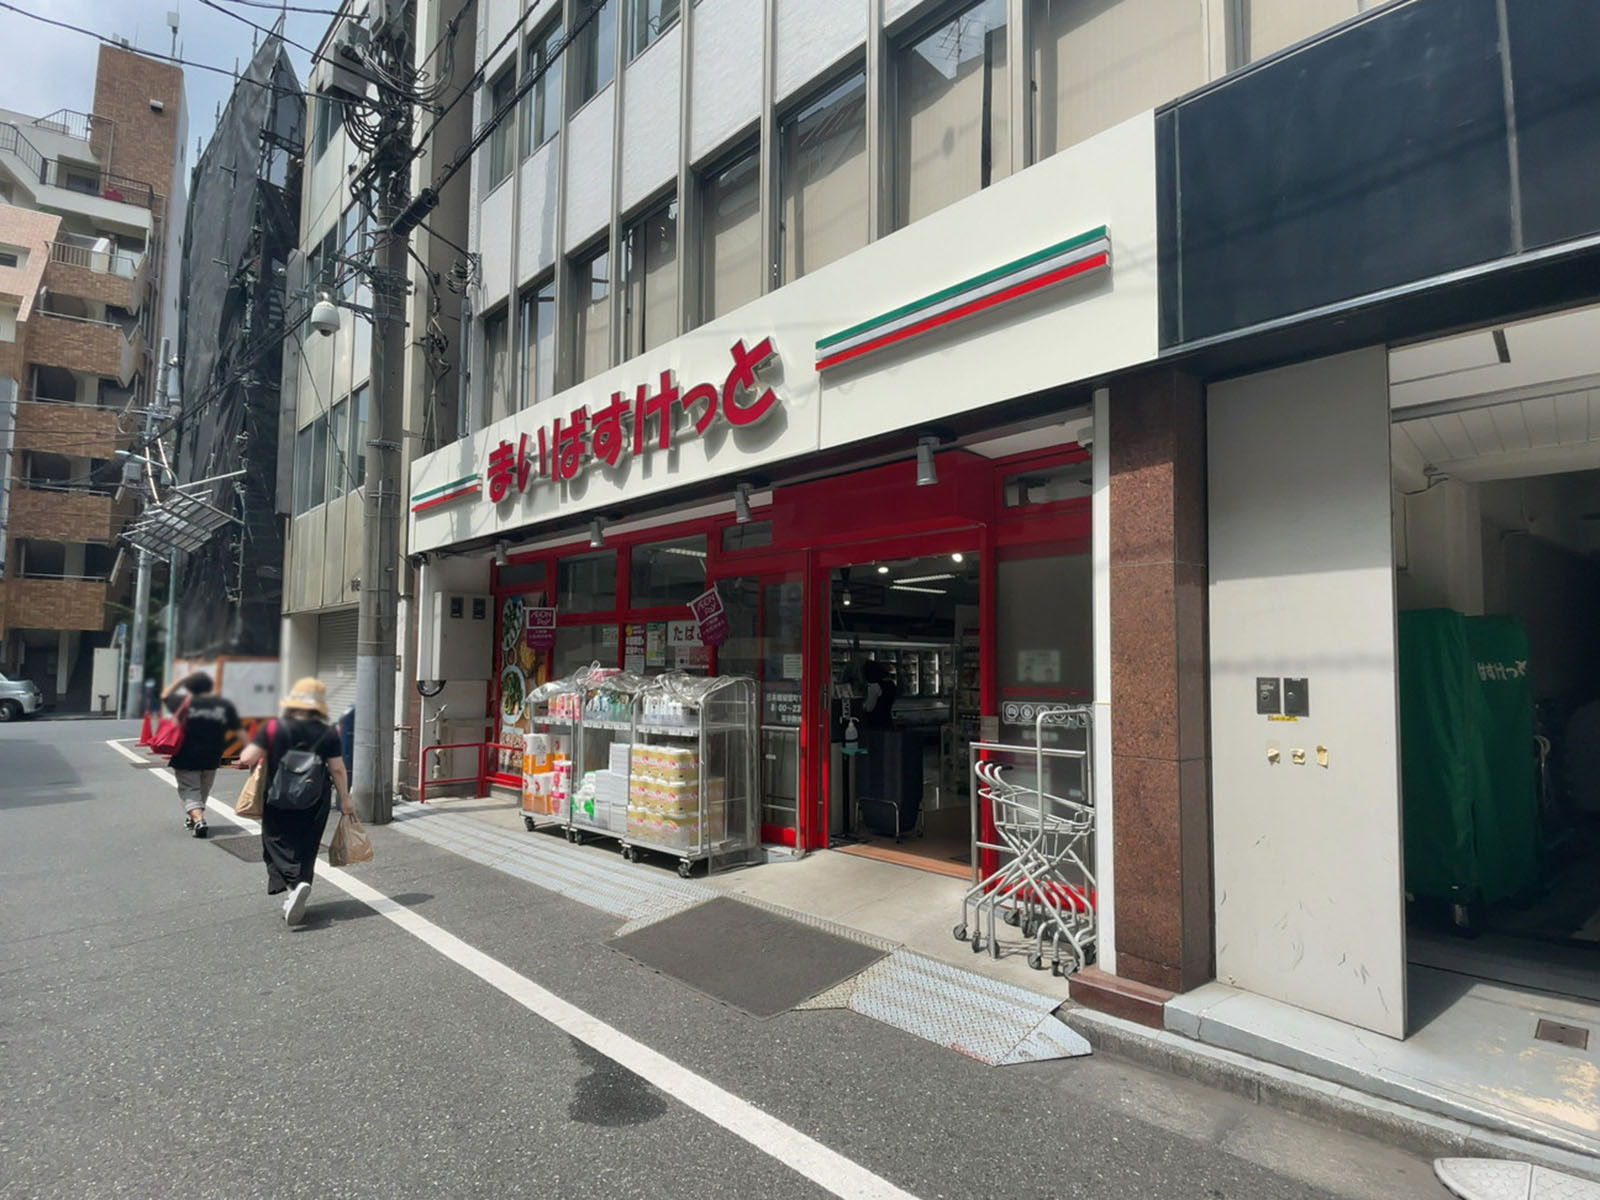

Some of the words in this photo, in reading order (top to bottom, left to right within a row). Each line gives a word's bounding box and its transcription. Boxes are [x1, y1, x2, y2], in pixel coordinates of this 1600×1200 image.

[487, 336, 779, 504] まいばすけっと
